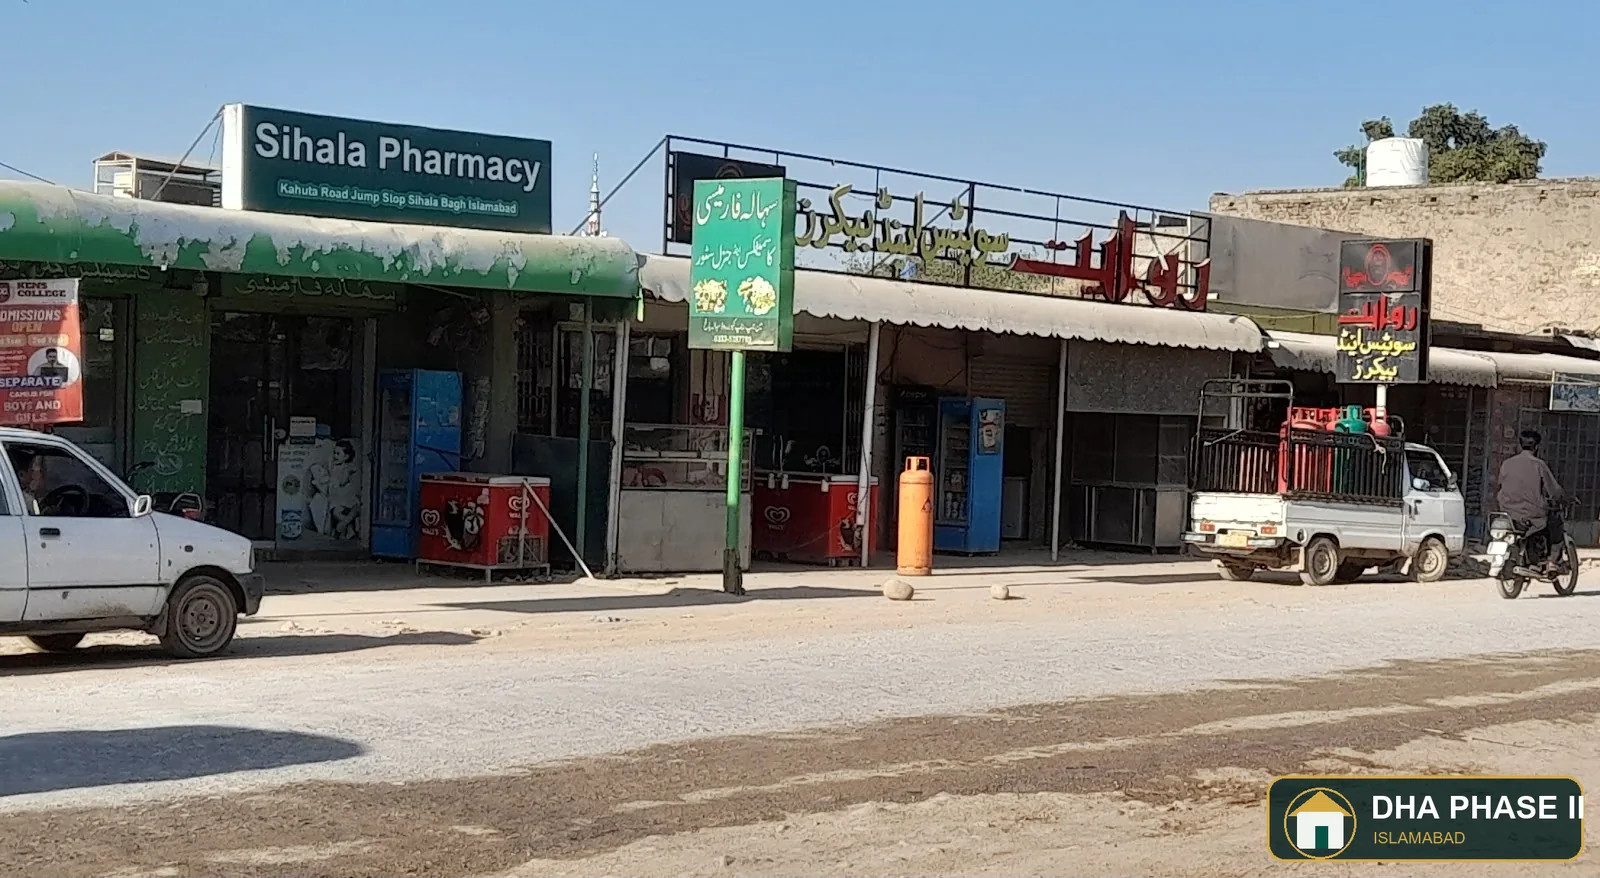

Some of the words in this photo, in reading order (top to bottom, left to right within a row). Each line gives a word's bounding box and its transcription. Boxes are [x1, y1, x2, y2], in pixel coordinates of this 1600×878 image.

[255, 122, 366, 168] Sihala
[379, 136, 541, 192] Pharmacy
[280, 183, 319, 197] Kahuta
[321, 187, 349, 200] Road
[351, 189, 380, 205] Jump
[408, 194, 439, 208] Sihala
[441, 196, 466, 212] Bagh
[468, 200, 517, 214] Islamabad
[740, 191, 779, 228] سہالہ
[1007, 209, 1211, 311] روایت
[17, 289, 67, 297] COLLEGE
[0, 309, 62, 321] DMISSIONS
[12, 321, 43, 333] OPEN
[0, 376, 62, 388] SEPARATE
[35, 400, 62, 410] AND
